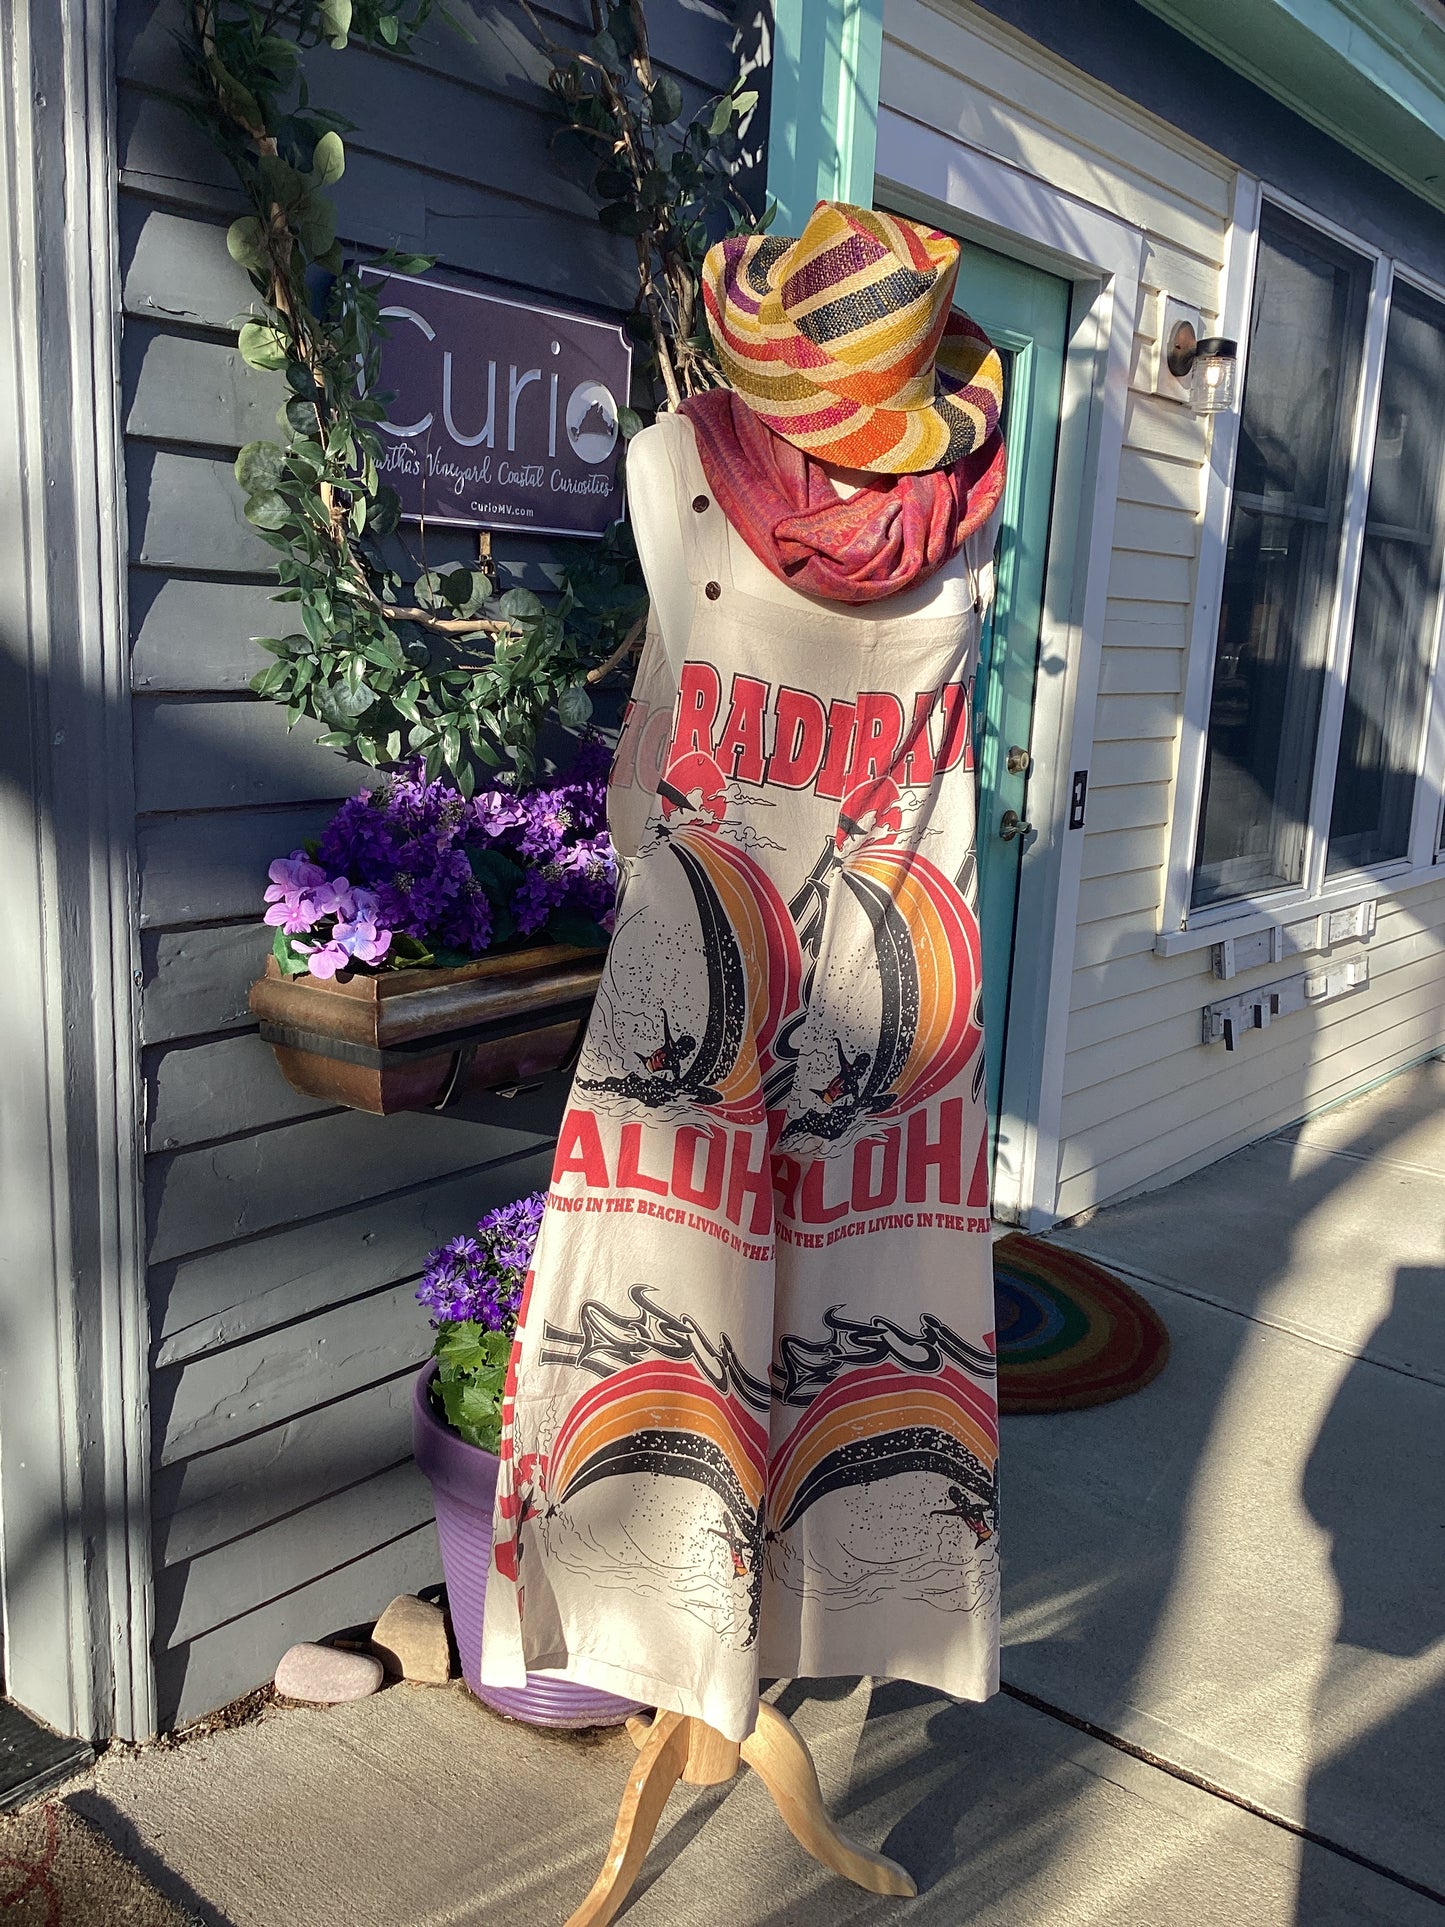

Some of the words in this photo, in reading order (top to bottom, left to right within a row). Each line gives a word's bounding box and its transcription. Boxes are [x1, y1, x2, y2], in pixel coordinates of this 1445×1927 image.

[356, 306, 618, 464] Curio
[373, 443, 420, 475] artha's
[426, 446, 492, 494] Vineyard
[498, 461, 544, 487] Coastal
[551, 469, 613, 497] Curiosities
[471, 501, 534, 517] CurioMV.com
[585, 1197, 603, 1213] IN
[604, 1198, 634, 1213] THE
[637, 1199, 685, 1225] BEACH
[687, 1213, 730, 1243] LIVING
[730, 1233, 742, 1252] IN
[742, 1242, 769, 1261] THE
[794, 1232, 825, 1249] THE
[827, 1221, 865, 1247] BEACH
[868, 1214, 914, 1233] LIVING
[917, 1213, 933, 1227] IN
[936, 1213, 964, 1231] THE
